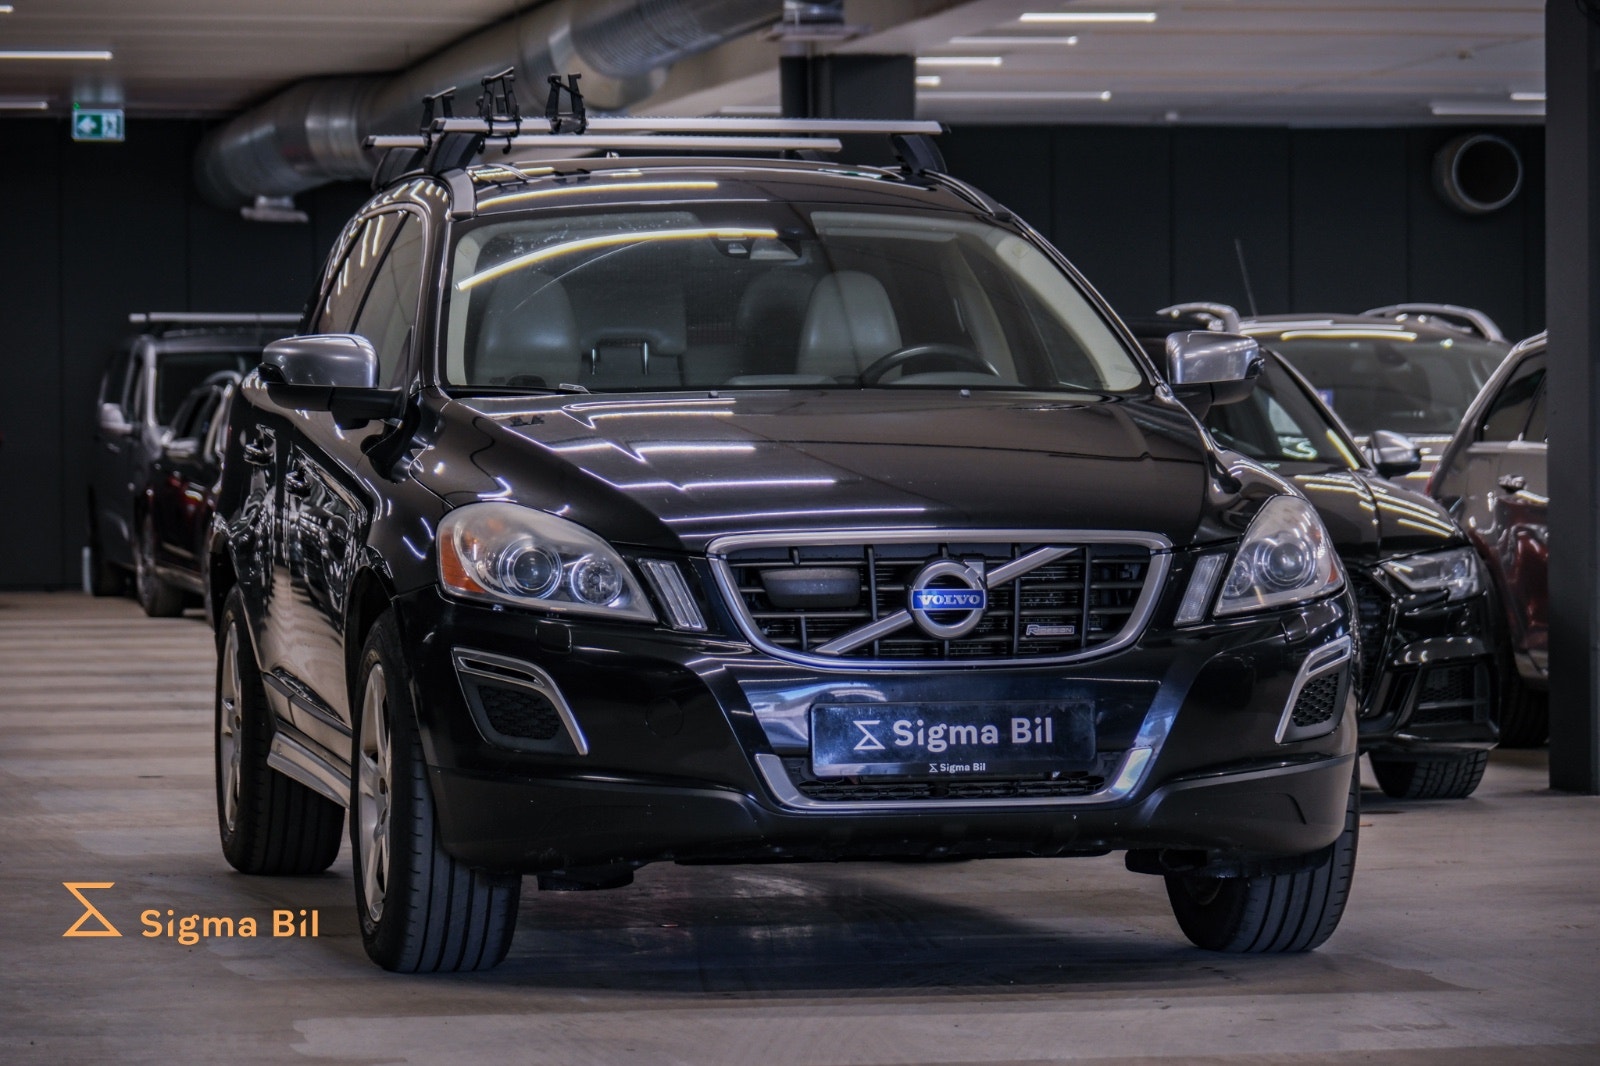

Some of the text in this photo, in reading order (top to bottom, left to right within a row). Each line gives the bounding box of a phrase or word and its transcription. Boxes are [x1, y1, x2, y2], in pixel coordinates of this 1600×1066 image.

[917, 594, 980, 605] VOLVO
[893, 717, 1053, 752] Sigma Bil
[940, 763, 985, 773] Sigma Bil
